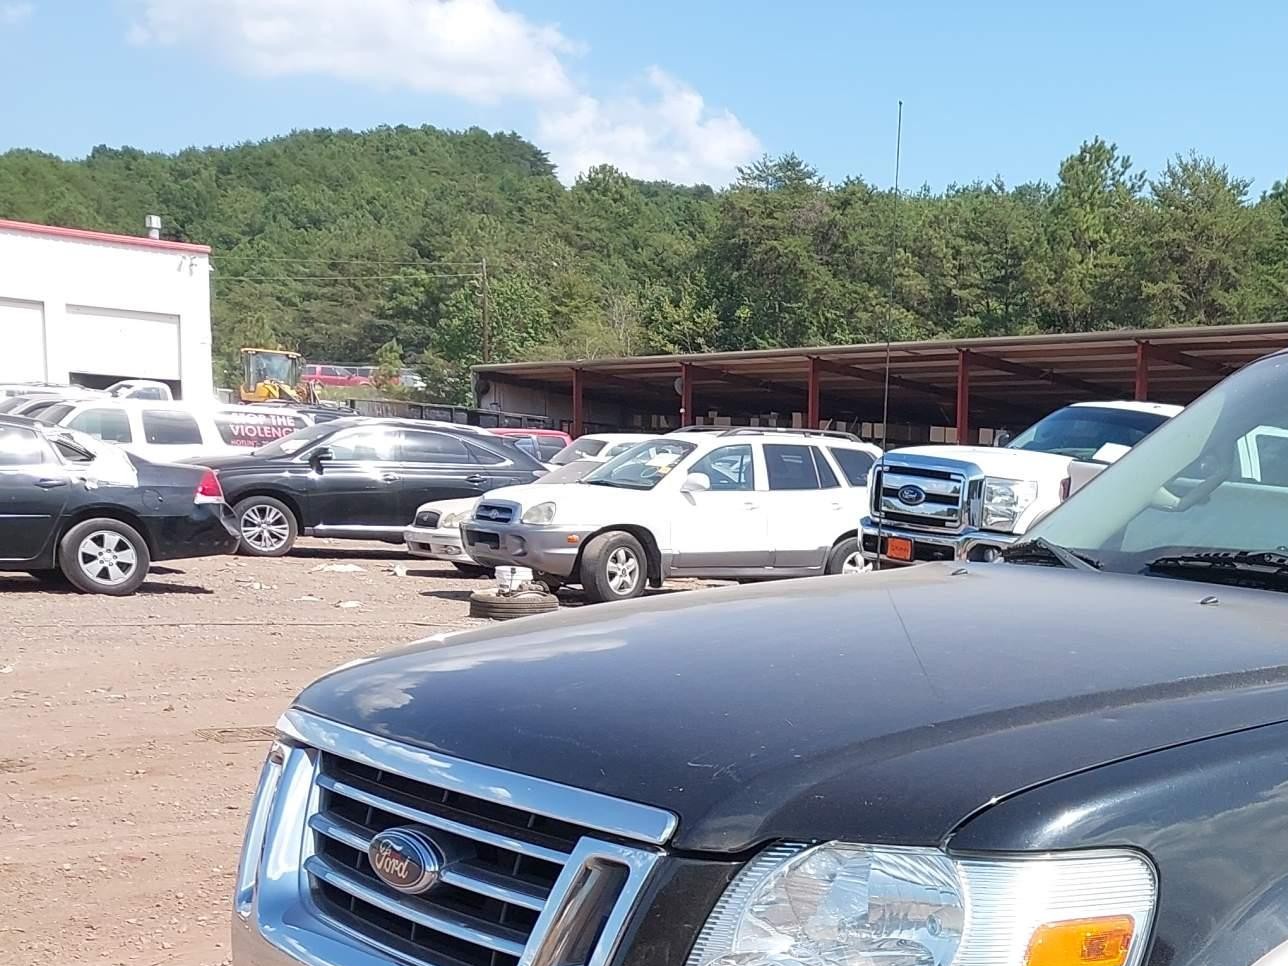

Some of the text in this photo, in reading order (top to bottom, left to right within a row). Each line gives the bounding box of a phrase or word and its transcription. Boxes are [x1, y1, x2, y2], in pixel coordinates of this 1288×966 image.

[271, 415, 295, 427] THE
[229, 424, 299, 438] VIOLENC
[375, 839, 412, 879] Ford
